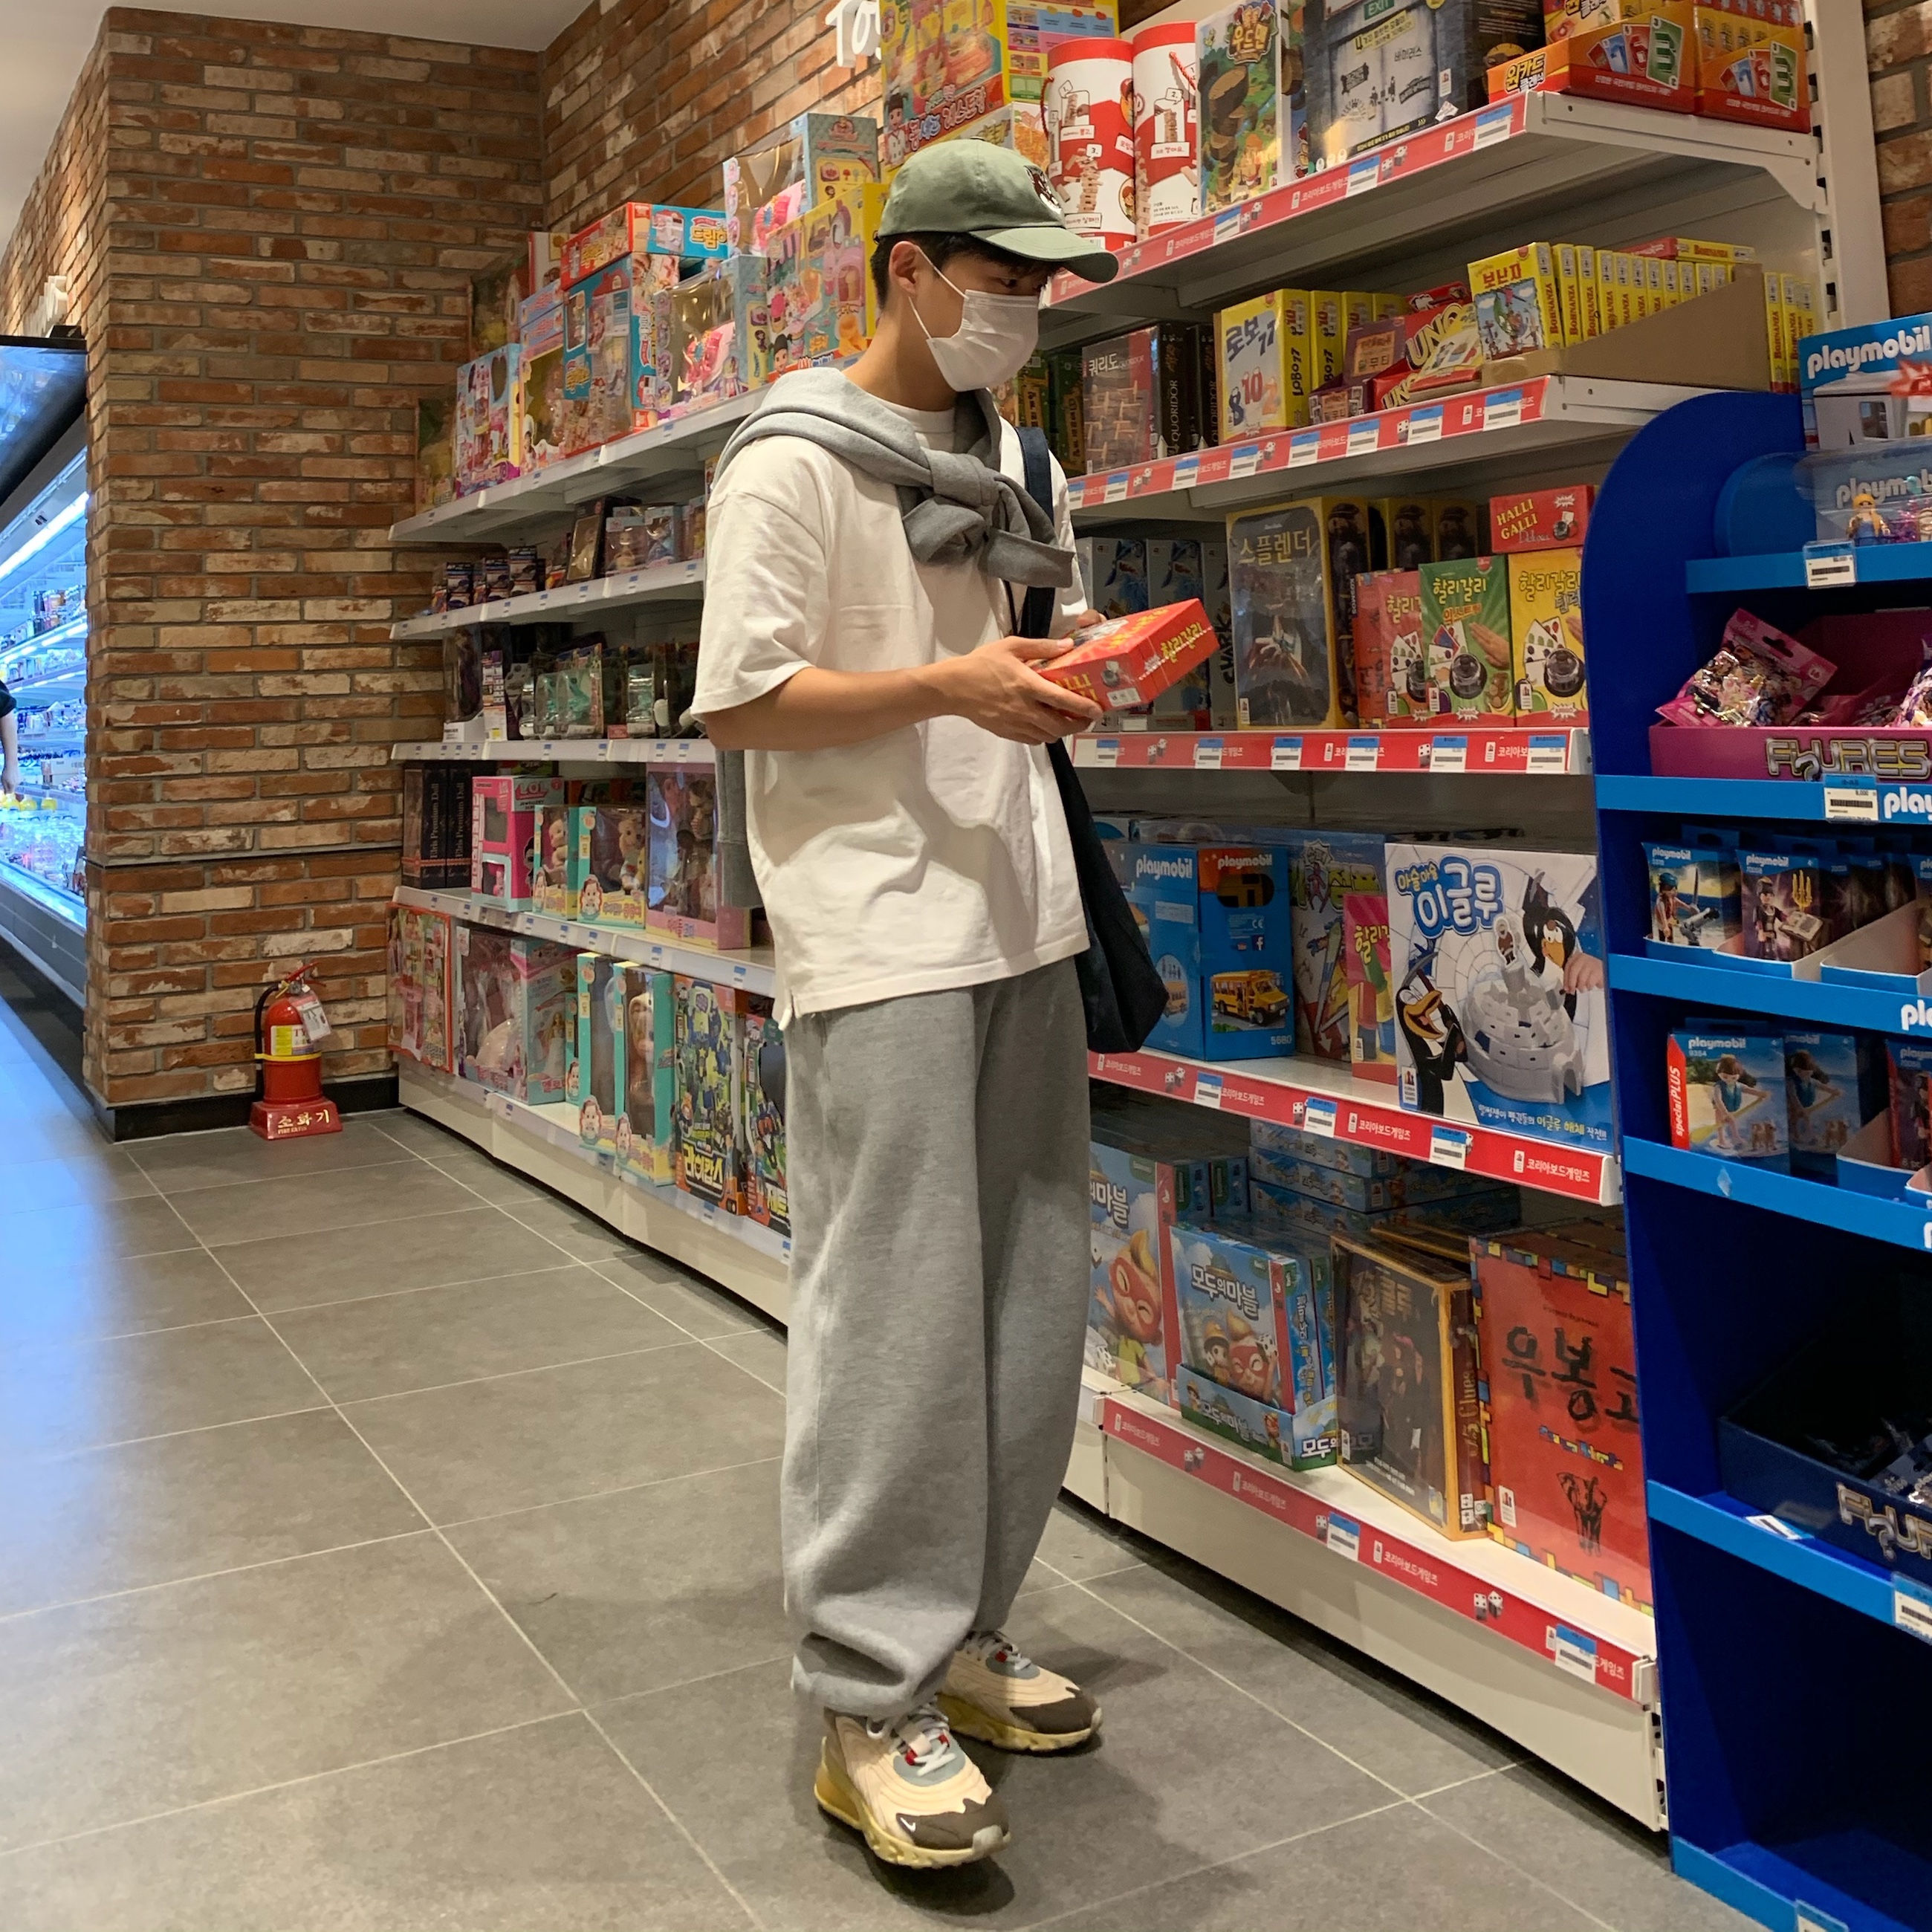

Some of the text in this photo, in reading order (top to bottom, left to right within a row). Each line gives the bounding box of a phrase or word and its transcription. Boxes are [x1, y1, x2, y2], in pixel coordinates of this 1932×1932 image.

[1233, 23, 1271, 50] 우드맨
[1482, 262, 1522, 288] 보난자
[1546, 283, 1559, 334] BOHNANZA
[1568, 285, 1578, 335] BOHNANZA
[1407, 303, 1462, 370] UNO
[1771, 311, 1782, 359] BOHNANZA
[1089, 353, 1118, 377] 쿼리도
[1807, 325, 1931, 380] playmobil
[1291, 347, 1305, 395] LOBO77
[1170, 380, 1180, 442] QUORIDOR
[1497, 498, 1534, 526] HALLI
[1500, 514, 1538, 541] GALLI
[1239, 527, 1312, 566] 스플렌더
[1433, 577, 1486, 604] 할리갈리
[1161, 622, 1204, 664] 할리갈리
[1218, 855, 1273, 869] playmobil
[1652, 846, 1691, 860] playmobil
[1745, 853, 1789, 869] playmobil
[1136, 855, 1193, 879] playmobil
[1416, 860, 1499, 929] 이글루
[1688, 1037, 1746, 1049] playmobil
[277, 1109, 330, 1128] 소화기
[1358, 1119, 1411, 1141] 코리아보드게임즈
[1536, 1115, 1562, 1132] 이글루
[1526, 1158, 1590, 1183] 코리아보드게임즈
[1191, 1265, 1260, 1320] 모두의마블
[1458, 1369, 1479, 1418] Clues
[1384, 1552, 1439, 1586] 코리아보드게임즈
